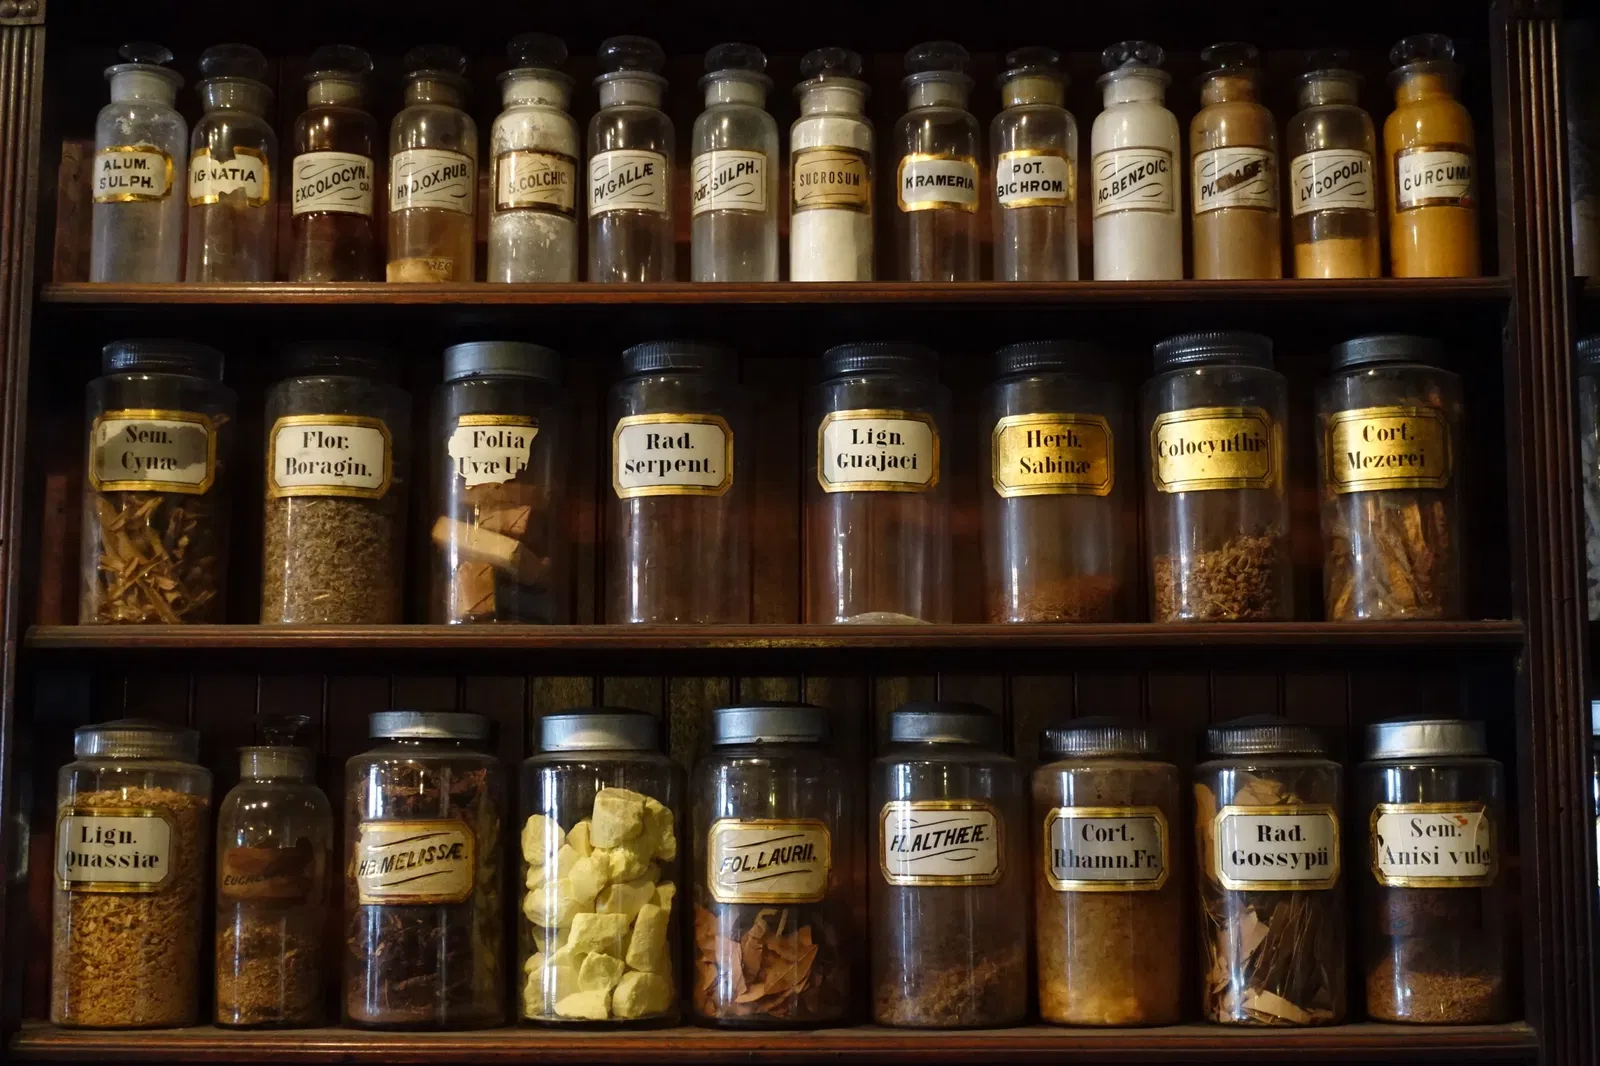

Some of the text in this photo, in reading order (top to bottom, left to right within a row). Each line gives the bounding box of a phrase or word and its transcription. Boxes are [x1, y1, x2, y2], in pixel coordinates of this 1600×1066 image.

[103, 158, 150, 171] ALUM.
[1012, 162, 1044, 176] POT.
[100, 175, 154, 189] SULPH.
[194, 168, 256, 183] IGNATIA
[799, 171, 860, 187] SUCROSUM
[905, 174, 974, 190] KRAMERIA
[997, 179, 1065, 198] BICHROM.
[125, 425, 173, 444] Sem.
[472, 430, 525, 449] Folia
[646, 432, 695, 450] Rad.
[851, 428, 905, 448] Lign.
[1025, 430, 1082, 448] Herb.
[1362, 423, 1414, 443] Cort.
[285, 456, 372, 477] Boragin.
[624, 457, 716, 477] Serpent.
[836, 450, 918, 472] Guajaci
[1346, 449, 1425, 470] Mezerei
[1081, 823, 1135, 843] Cort.
[1256, 825, 1306, 842] Rad.
[1410, 817, 1462, 837] Sem.
[80, 826, 137, 848] Lign.
[1231, 847, 1328, 870] Gossypii
[1382, 845, 1439, 865] Anisi
